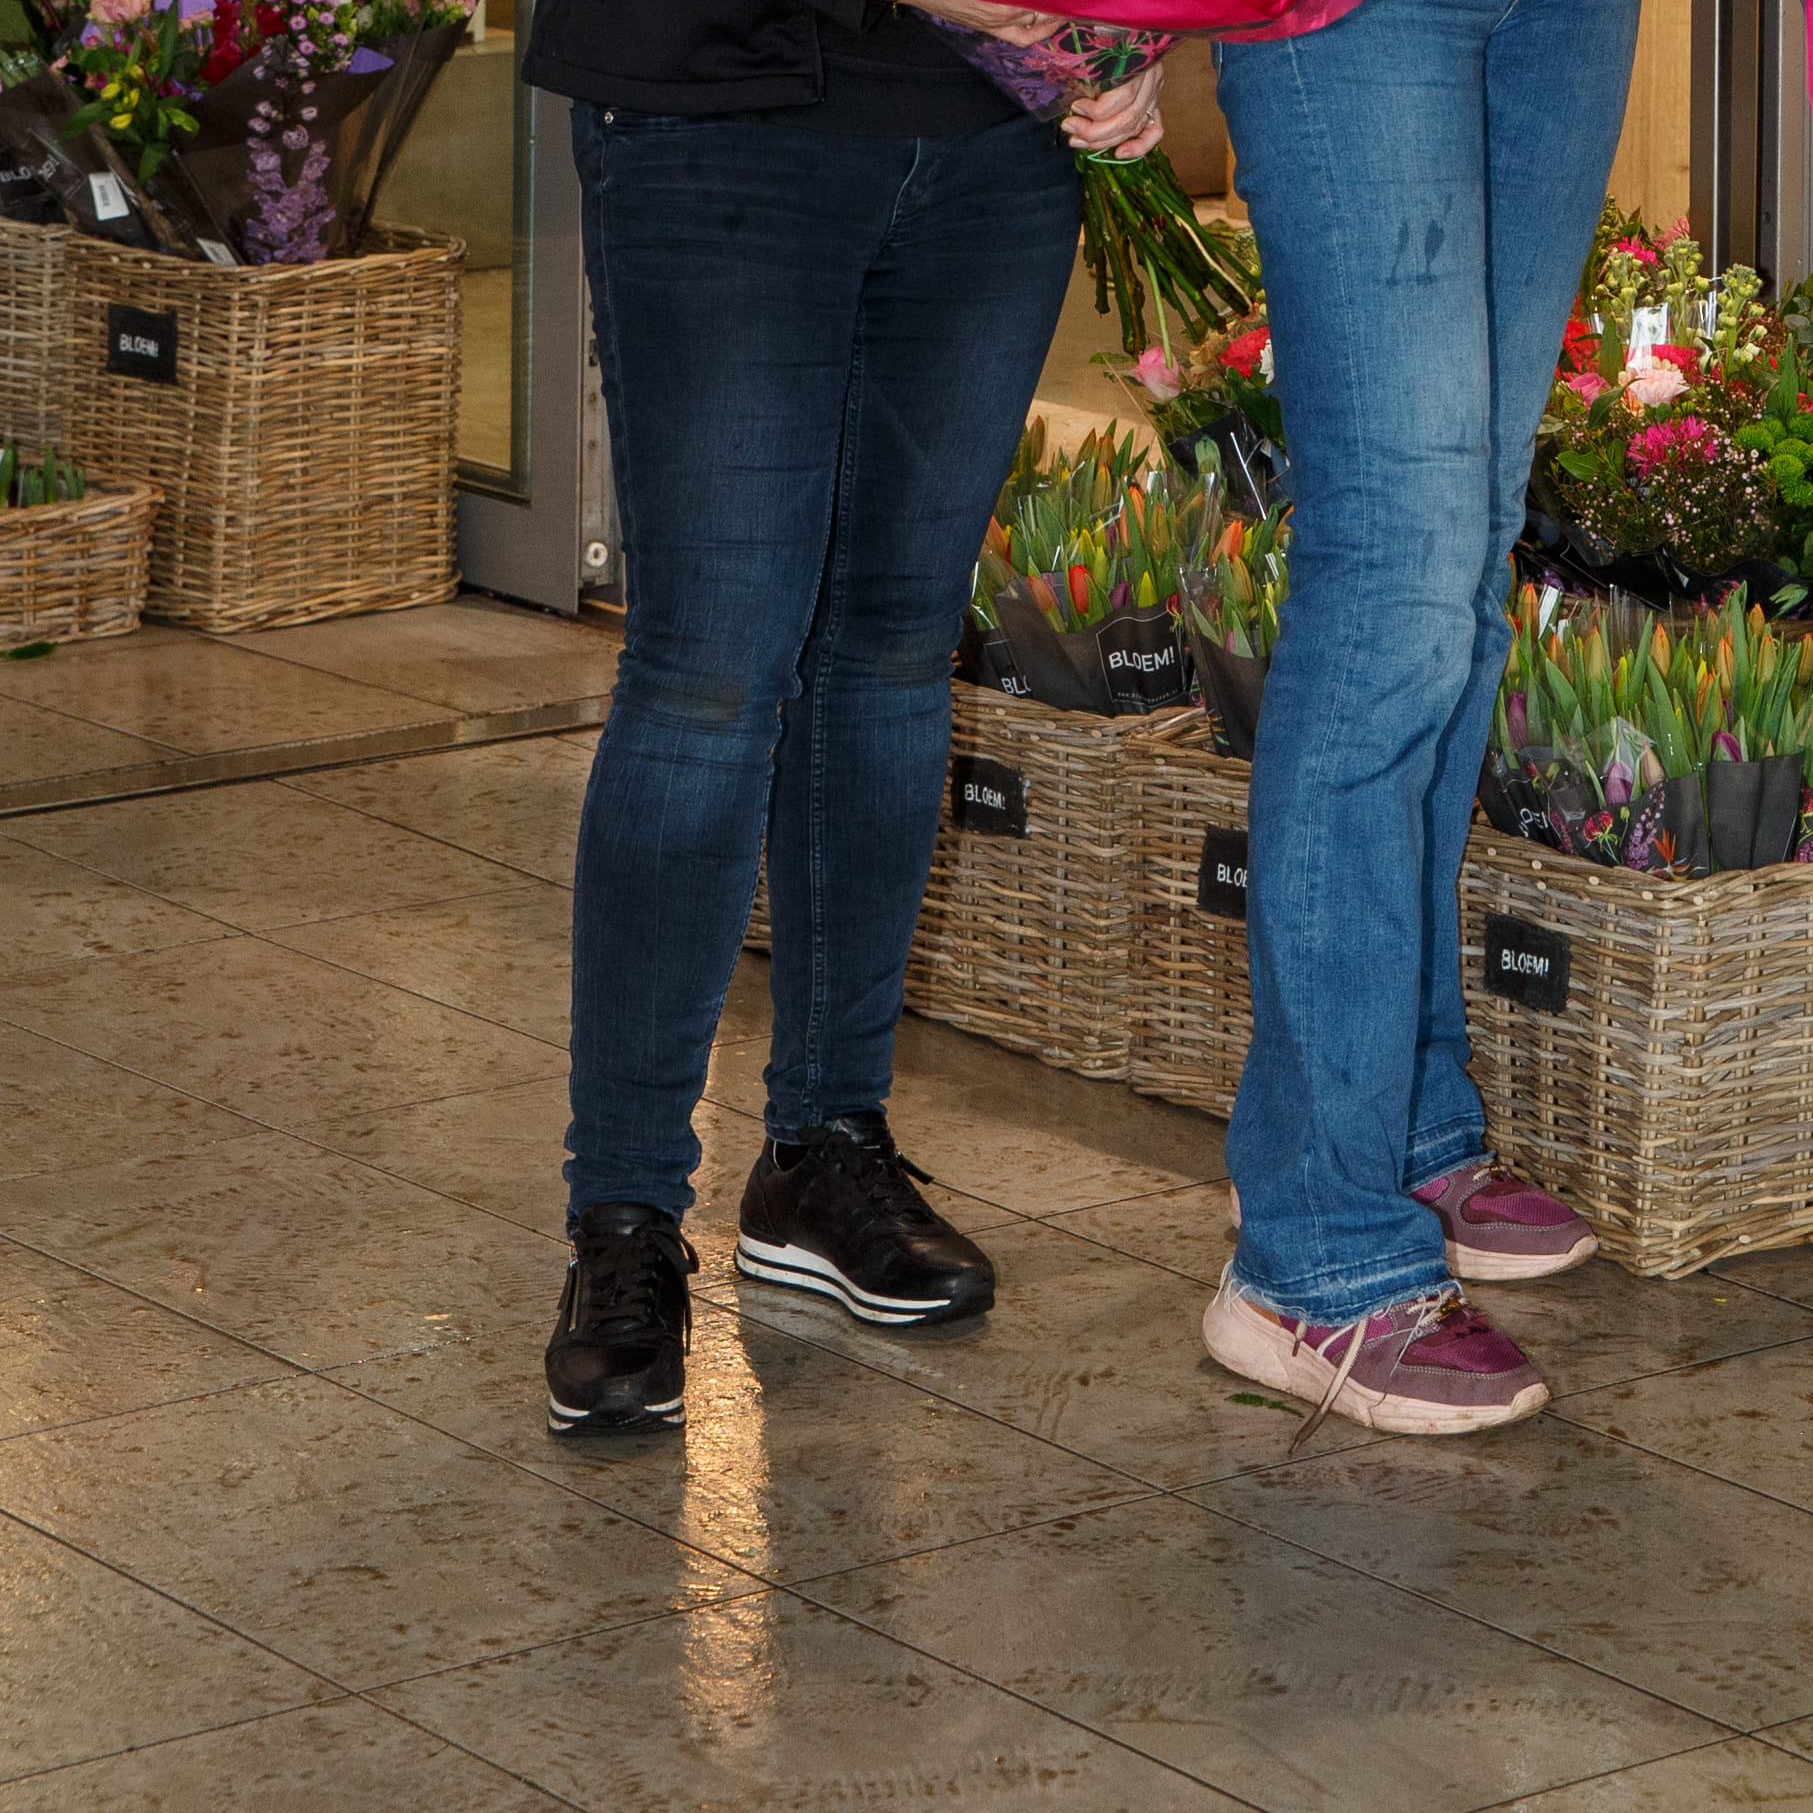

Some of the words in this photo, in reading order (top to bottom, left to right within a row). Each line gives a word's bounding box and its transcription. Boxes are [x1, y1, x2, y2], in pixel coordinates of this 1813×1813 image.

[119, 333, 159, 358] BLOEM!
[1108, 646, 1176, 673] BLOEM!
[964, 783, 1006, 811] BLOEM!
[1502, 948, 1550, 977] BLOEM!
